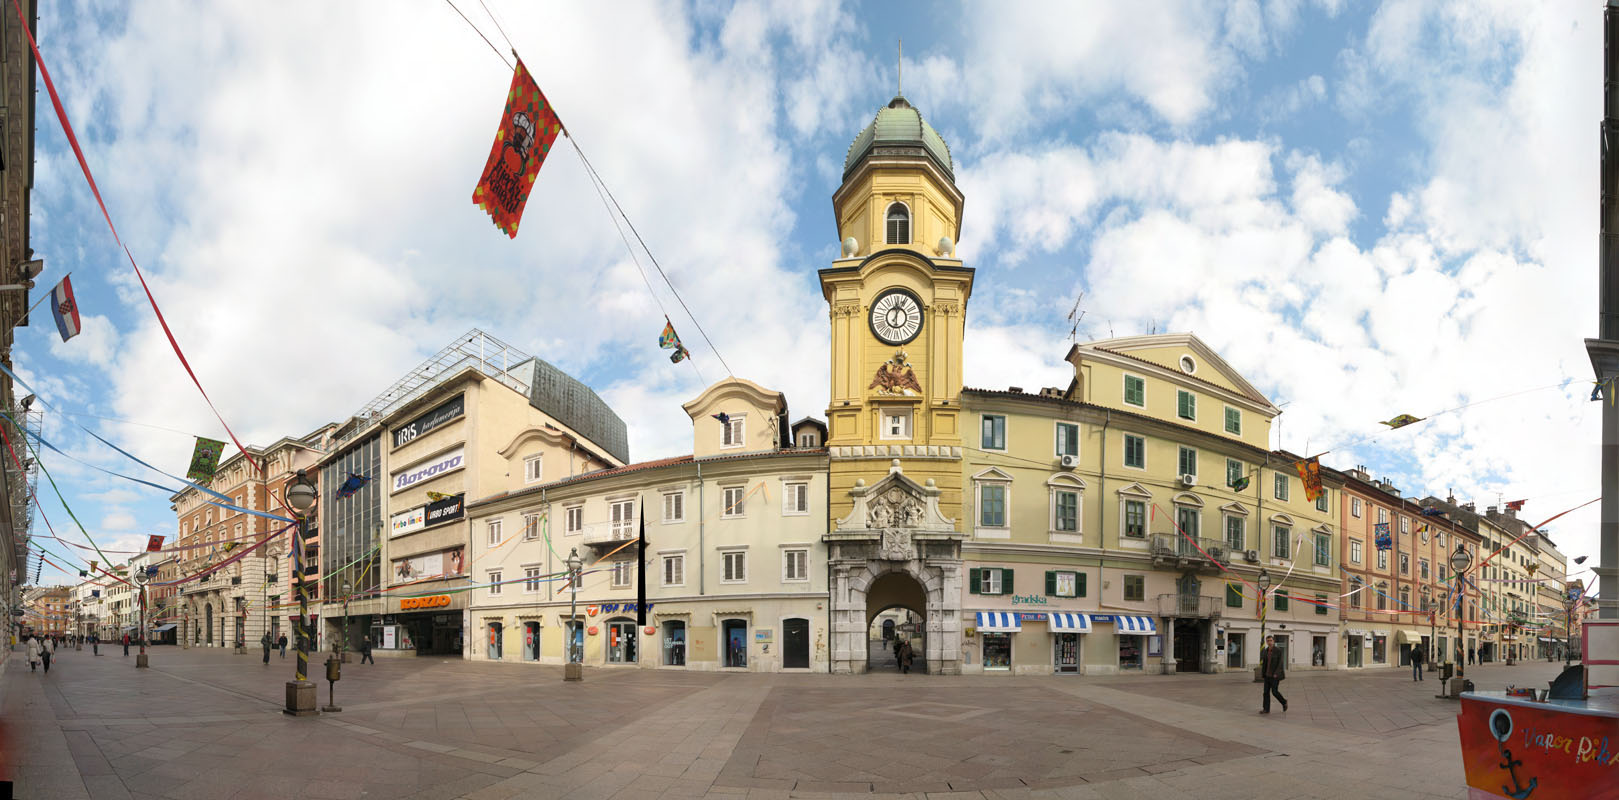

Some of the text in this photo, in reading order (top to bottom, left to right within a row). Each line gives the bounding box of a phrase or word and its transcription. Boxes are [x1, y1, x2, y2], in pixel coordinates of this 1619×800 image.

[400, 594, 451, 610] KORZO
[1011, 594, 1047, 605] gradska
[600, 603, 655, 613] TOP SPOT
[1521, 727, 1573, 755] Vapor
